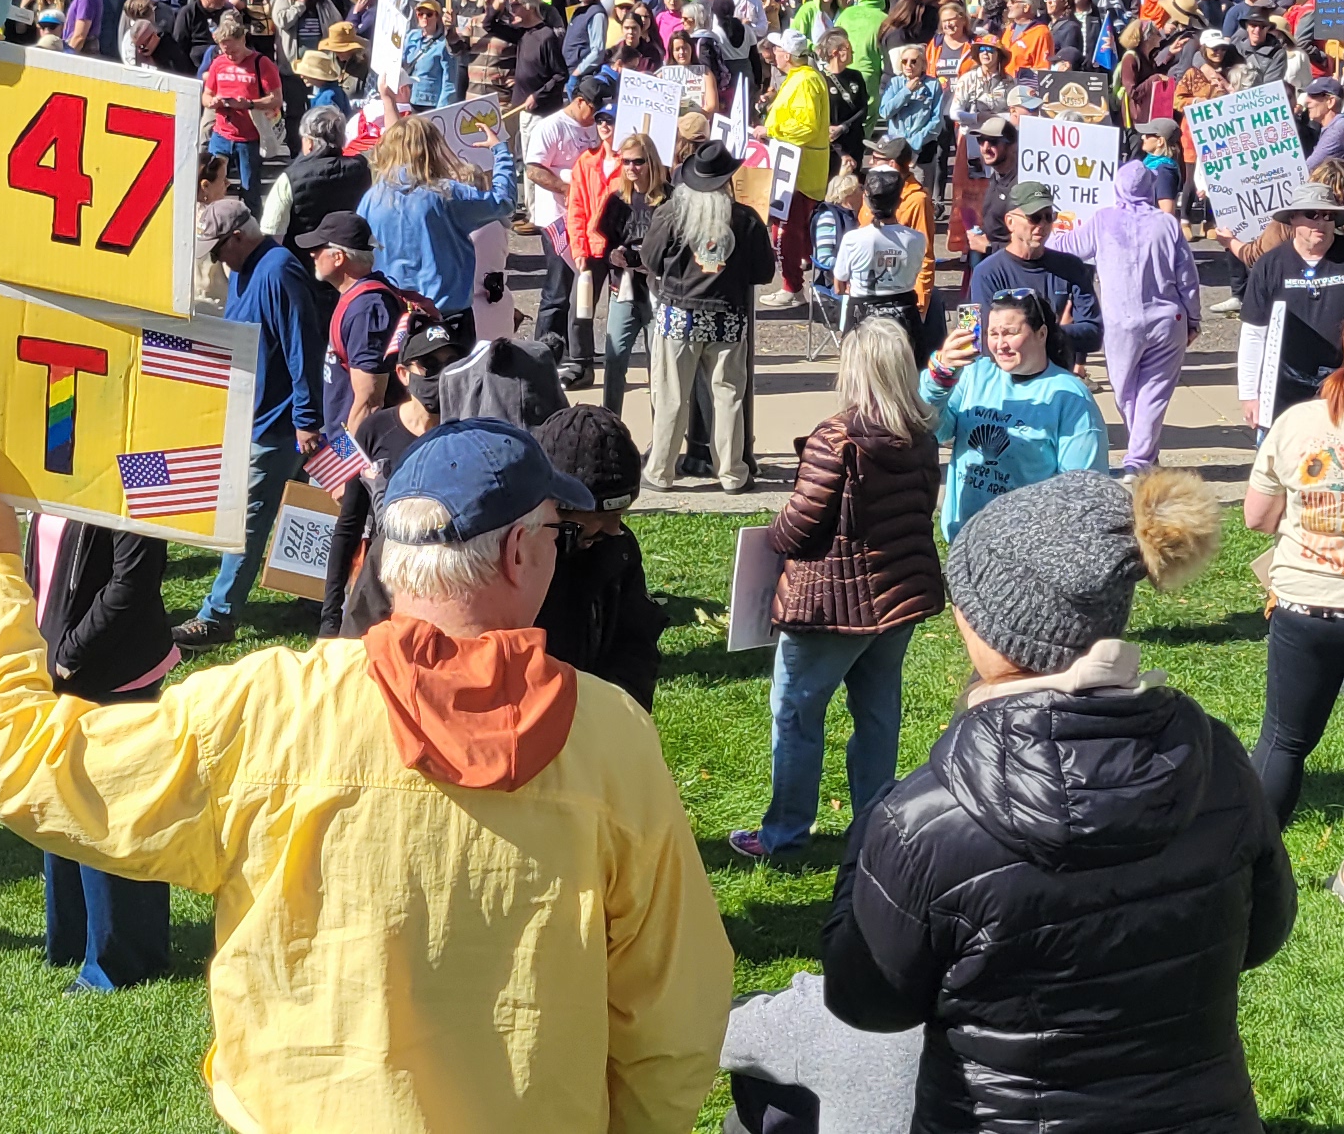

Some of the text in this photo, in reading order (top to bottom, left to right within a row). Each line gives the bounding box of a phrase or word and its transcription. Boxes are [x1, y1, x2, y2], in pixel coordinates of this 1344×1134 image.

[623, 76, 667, 93] PRO-CAT
[1228, 92, 1285, 115] JOHNSON,
[621, 94, 677, 116] ANTI-FASCIST
[1190, 86, 1267, 125] HEY MIKE
[1193, 104, 1290, 145] I DON'T HATE
[1052, 124, 1080, 149] NO
[1201, 121, 1296, 163] AMERICA
[1203, 136, 1300, 176] BUT I DO HATE
[8, 91, 176, 257] 47
[1208, 183, 1233, 196] PEDOS
[1070, 186, 1099, 204] THE
[1215, 205, 1238, 218] RACISTS
[1236, 180, 1293, 220] NAZIS
[284, 518, 305, 560] 1776
[301, 521, 321, 564] Since
